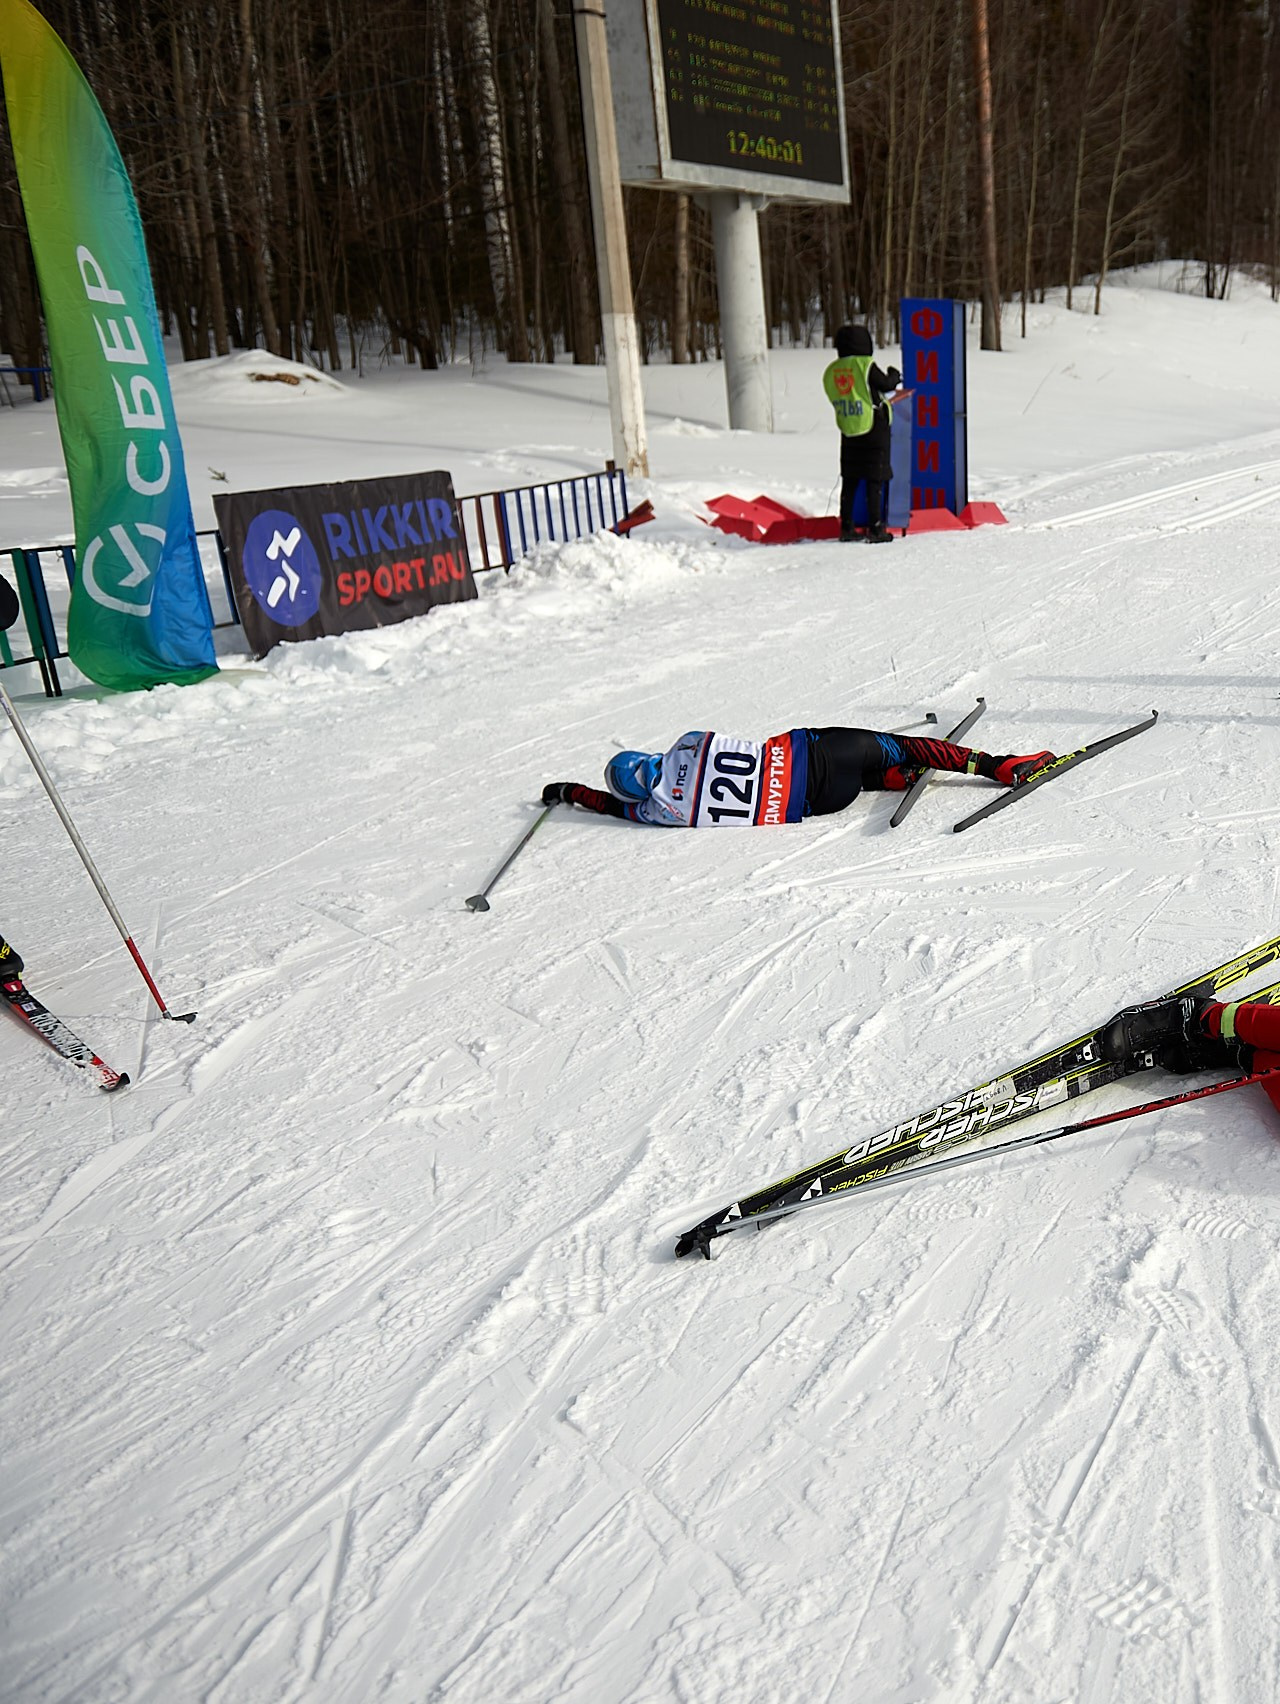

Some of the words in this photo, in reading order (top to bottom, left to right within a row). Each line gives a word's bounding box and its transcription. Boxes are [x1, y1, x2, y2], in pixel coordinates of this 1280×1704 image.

[76, 245, 171, 496] СБЕР
[322, 498, 457, 561] RIKKIR
[337, 551, 465, 606] SPORT.RU
[676, 764, 688, 786] ПСБ
[707, 751, 756, 823] 120
[763, 746, 784, 826] ДМУРТИЯ
[918, 1078, 1067, 1151] FISCHER
